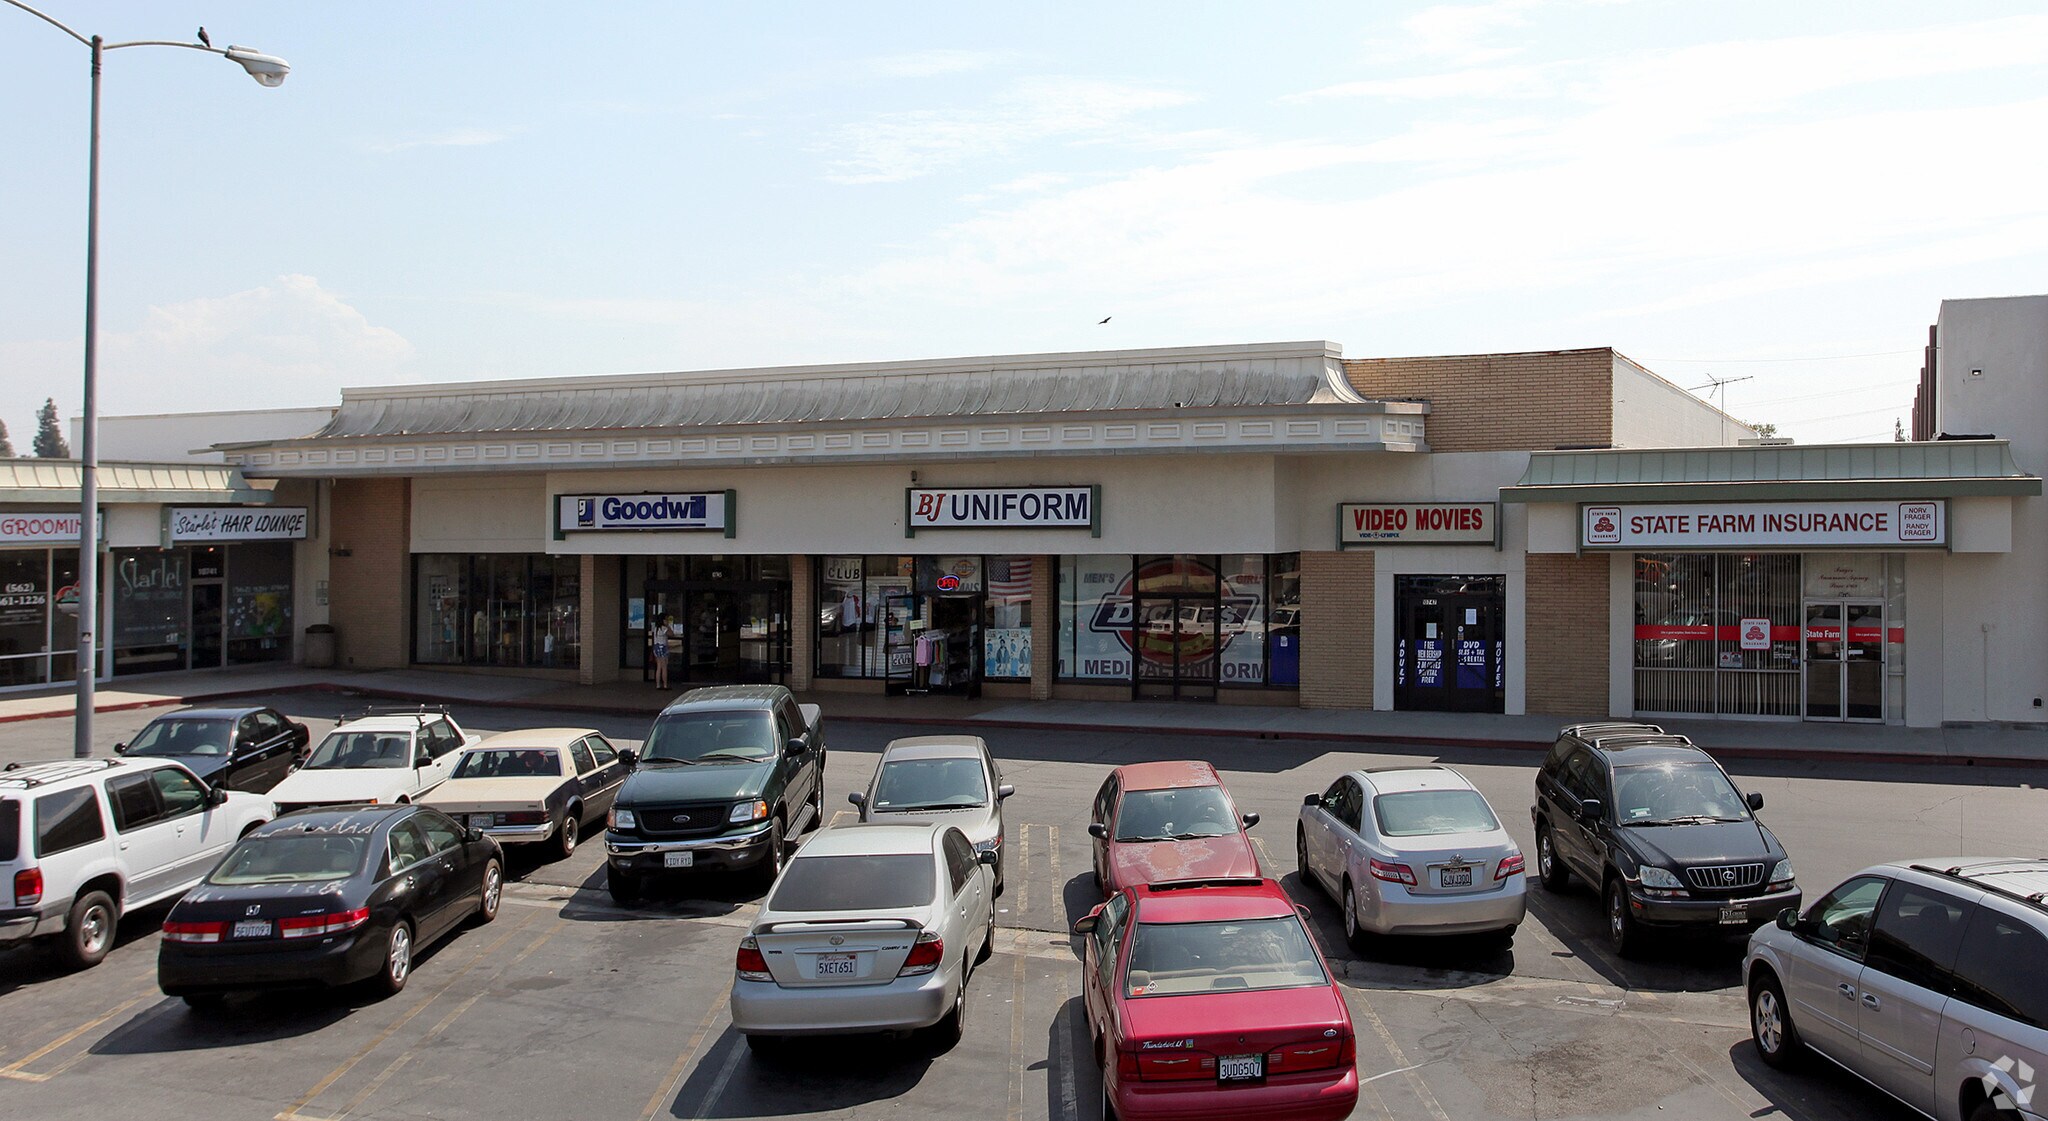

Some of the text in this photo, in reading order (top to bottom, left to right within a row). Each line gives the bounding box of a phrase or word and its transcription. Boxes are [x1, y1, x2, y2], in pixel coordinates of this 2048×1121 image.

[602, 495, 707, 521] Goodwill
[915, 493, 946, 522] BJ
[951, 493, 1088, 521] UNIFORM
[1, 518, 99, 536] GROOMI
[220, 514, 254, 533] HAIR
[254, 514, 305, 536] LOUNGE
[1353, 508, 1483, 531] VIDEO MOVIES
[1630, 513, 1888, 534] STATE FARM INSURANCE
[119, 556, 184, 598] Starlet
[828, 567, 860, 579] CLUB
[1083, 573, 1115, 584] MEN'S
[5, 582, 35, 593] (562)
[937, 578, 959, 588] OPEN
[0, 596, 45, 606] 61-1226
[1806, 630, 1840, 638] State Farm
[1463, 641, 1480, 649] DVD
[818, 962, 854, 974] 5XET651
[1221, 1062, 1260, 1078] 3UDG507
